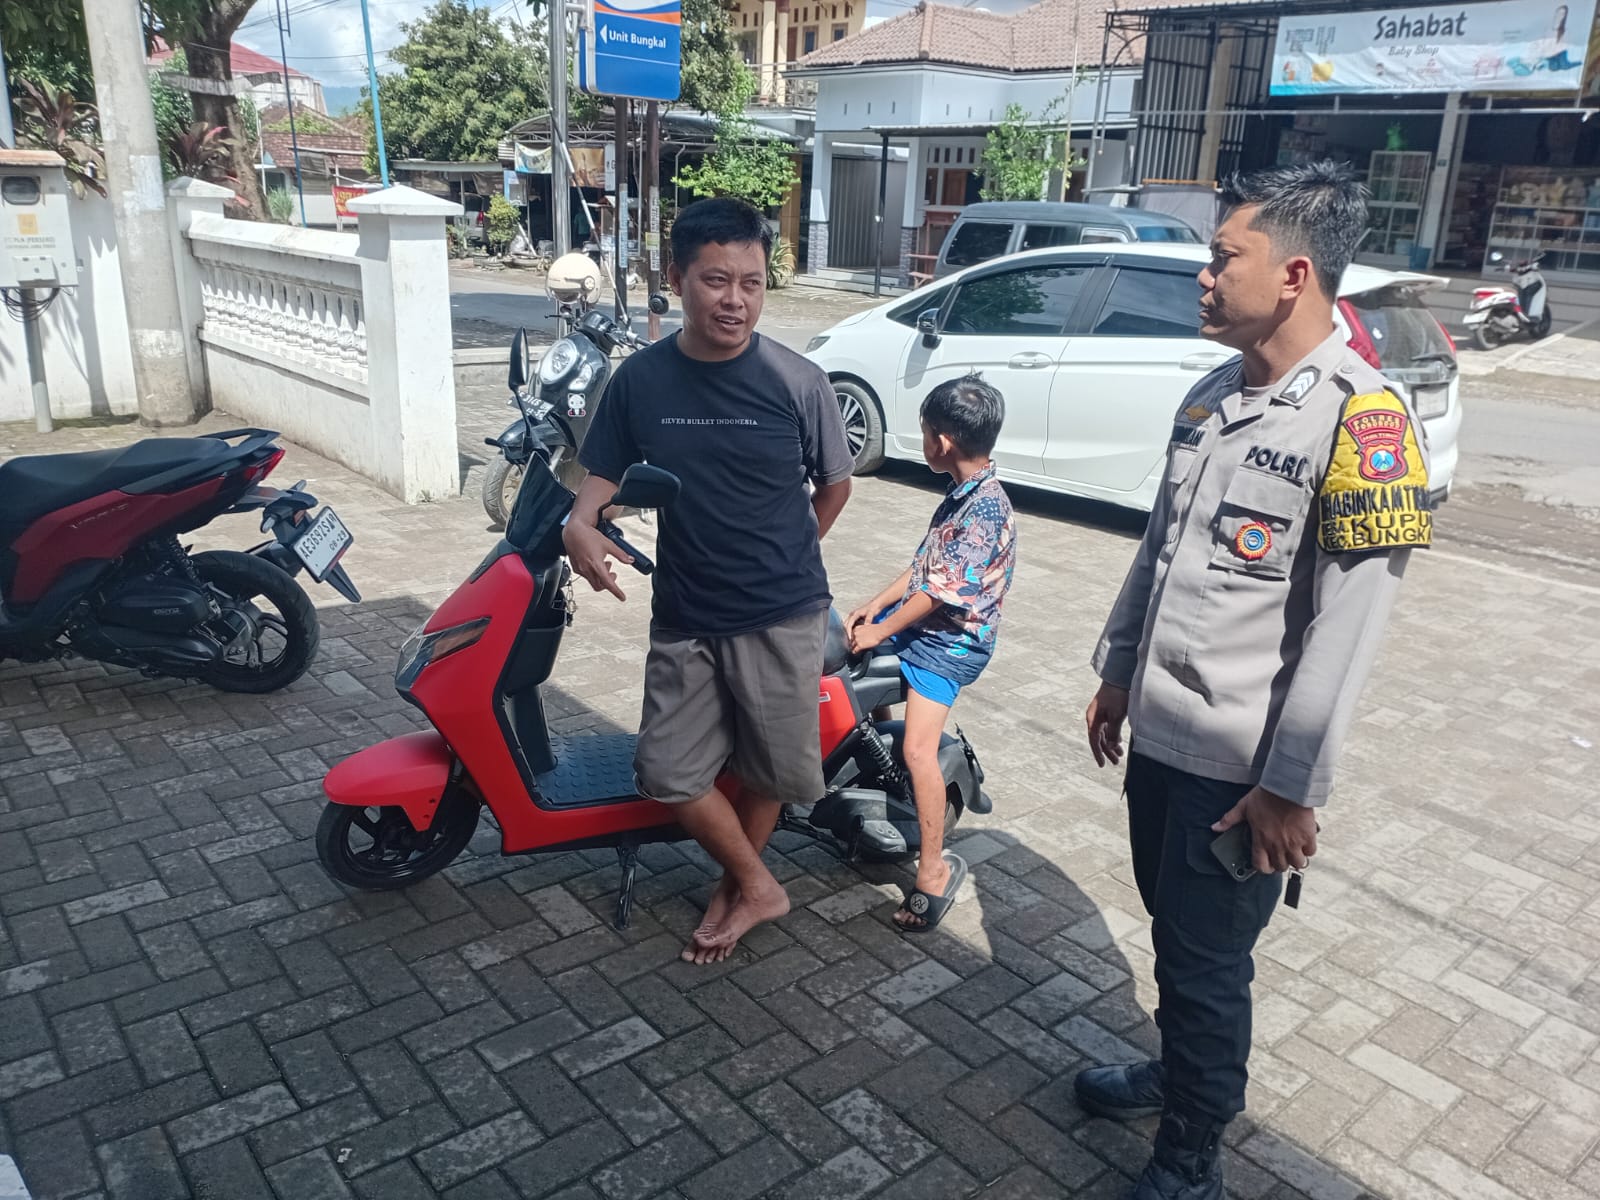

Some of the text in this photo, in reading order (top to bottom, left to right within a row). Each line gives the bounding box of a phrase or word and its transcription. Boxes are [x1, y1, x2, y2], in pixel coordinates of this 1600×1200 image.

[1374, 11, 1468, 40] Sahabat
[609, 30, 666, 48] Unit Bungkal
[1388, 45, 1439, 57] Baby Shop
[1245, 446, 1307, 479] POLRI
